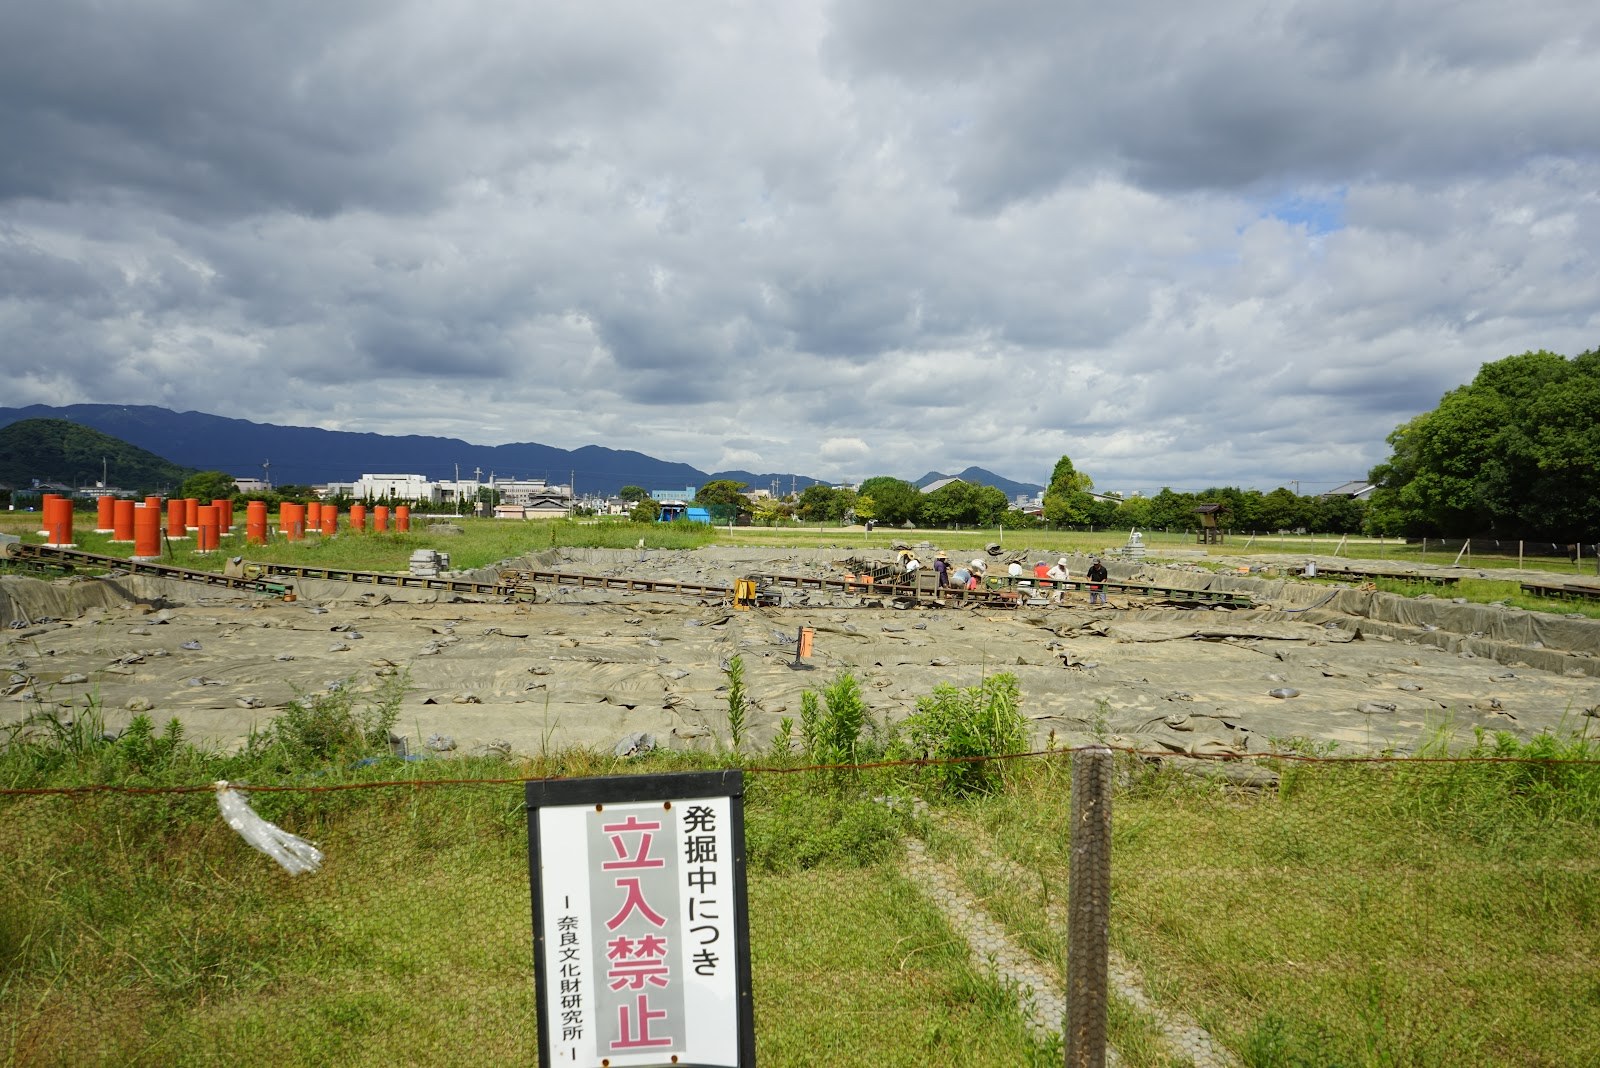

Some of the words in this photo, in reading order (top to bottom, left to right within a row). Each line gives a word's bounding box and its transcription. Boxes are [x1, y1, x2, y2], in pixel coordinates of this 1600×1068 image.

[602, 815, 672, 1050] 立入禁止
[683, 805, 719, 977] 発掘中につき
